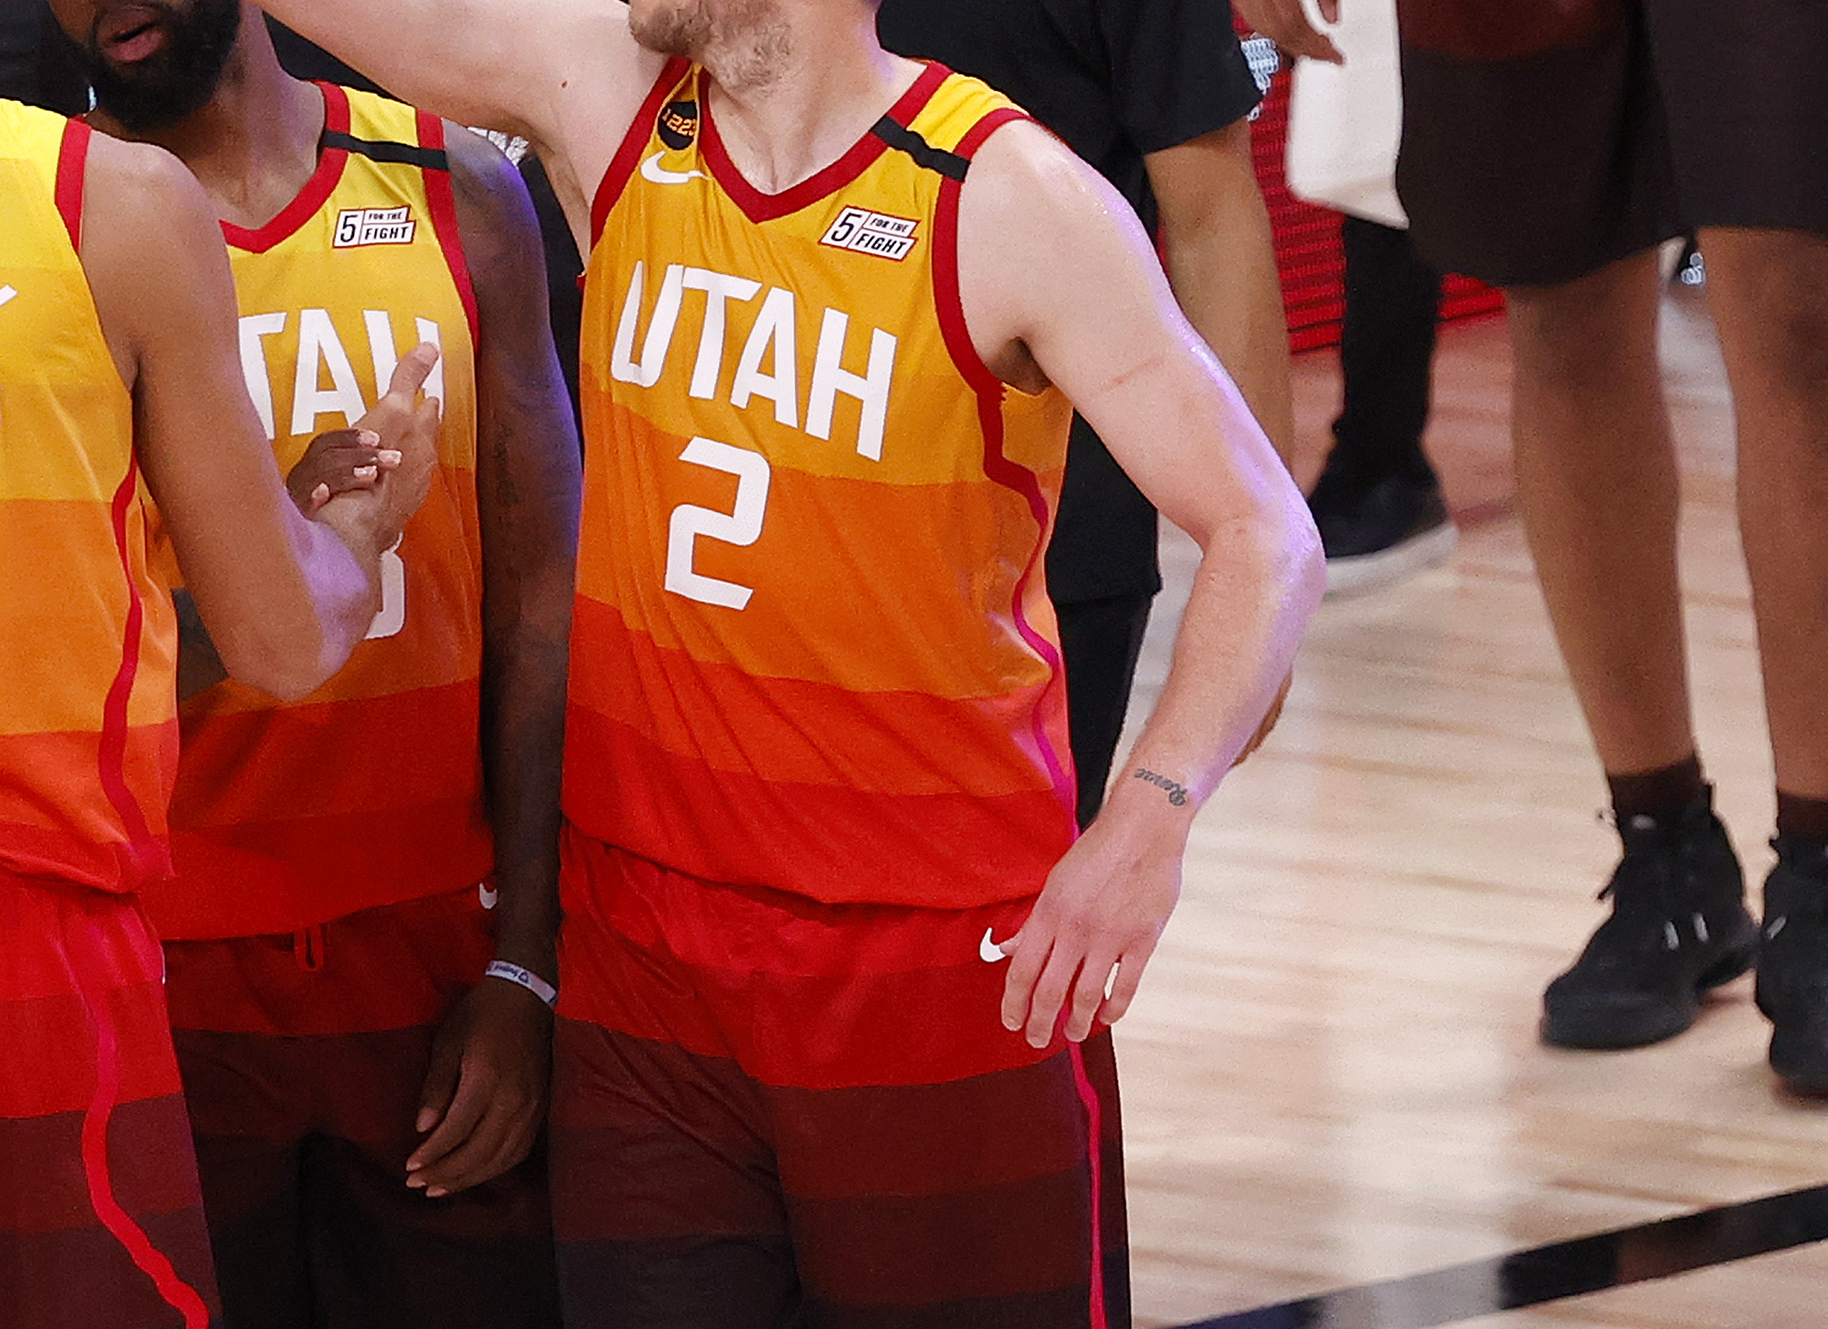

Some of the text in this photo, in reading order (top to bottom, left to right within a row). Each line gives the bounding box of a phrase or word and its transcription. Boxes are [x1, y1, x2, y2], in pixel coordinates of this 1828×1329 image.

[340, 214, 358, 243] 5
[364, 226, 409, 240] FIGHT
[830, 212, 863, 242] 5
[854, 233, 908, 255] FIGHT
[238, 308, 446, 441] TAH
[610, 260, 899, 464] UTAH
[664, 436, 772, 612] 2
